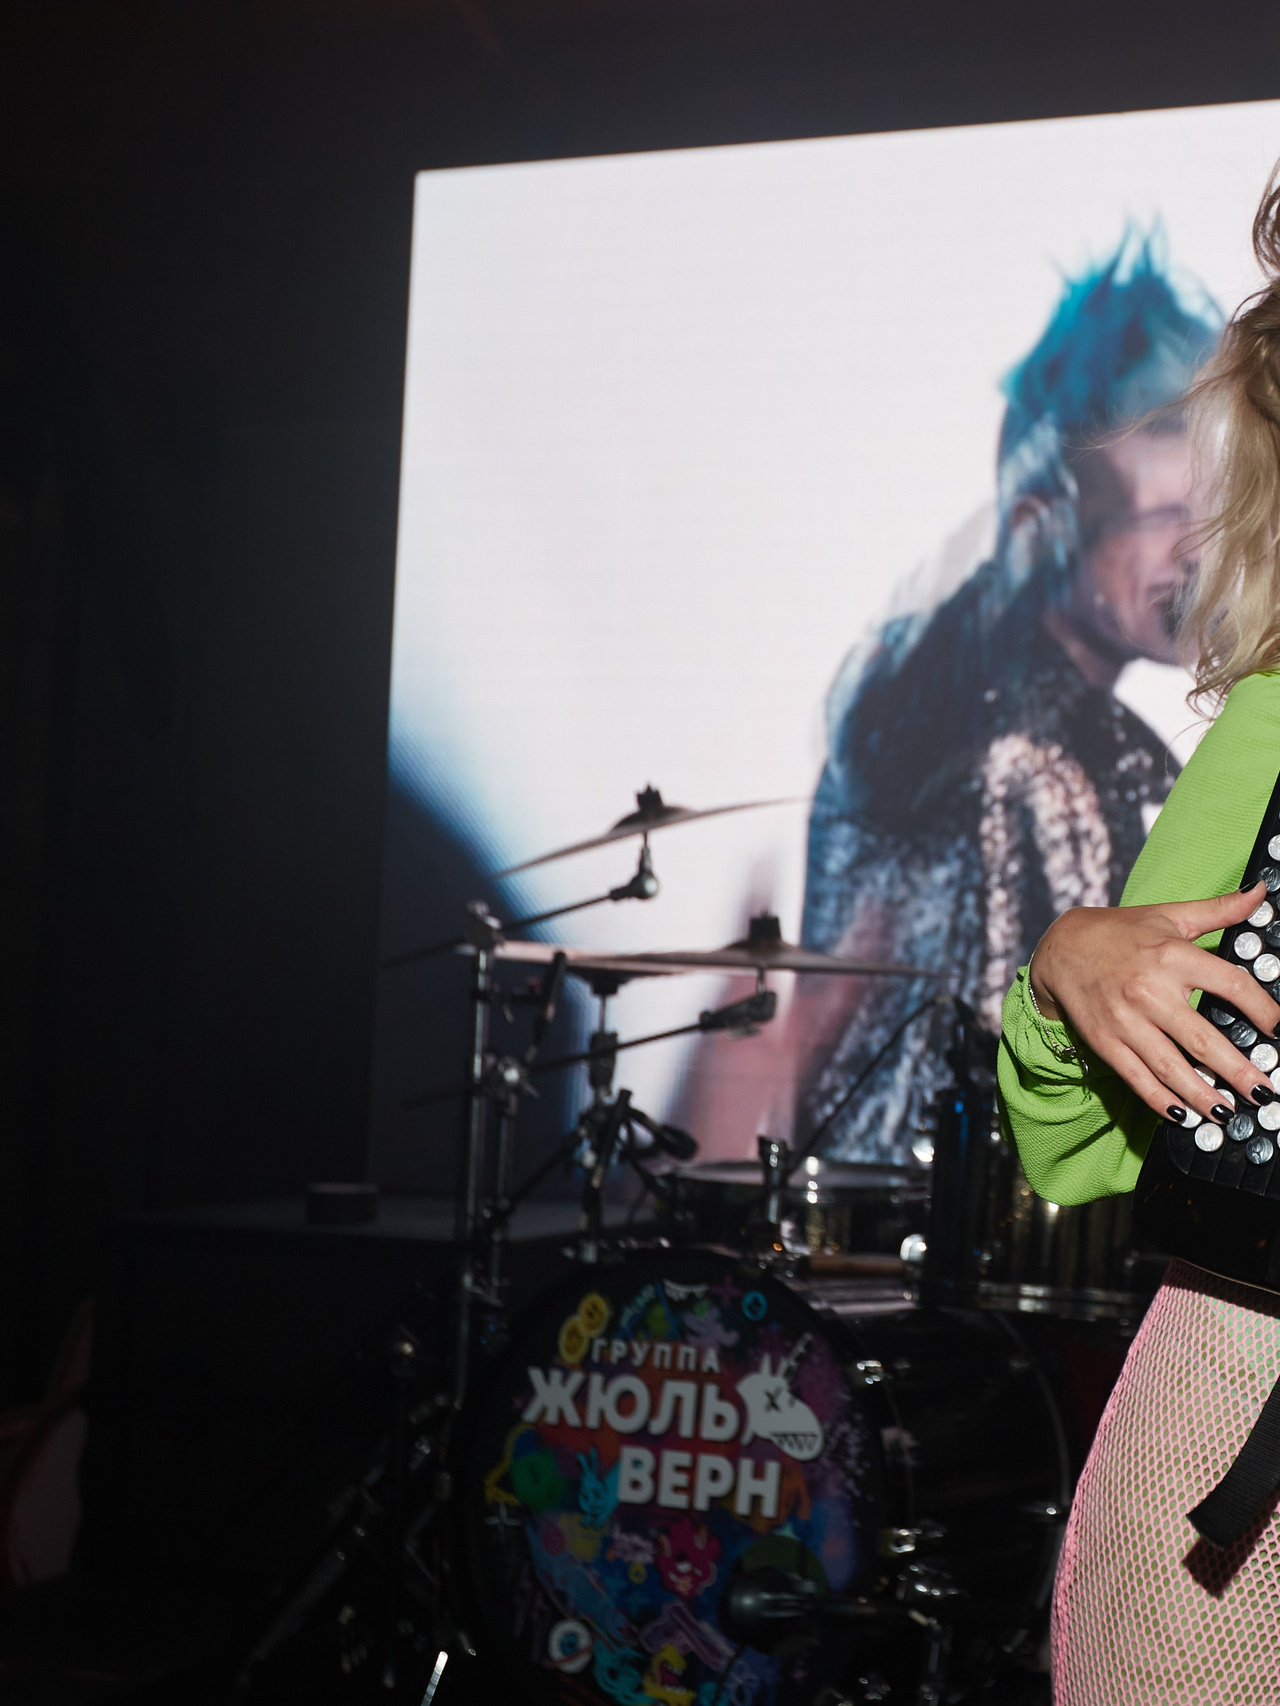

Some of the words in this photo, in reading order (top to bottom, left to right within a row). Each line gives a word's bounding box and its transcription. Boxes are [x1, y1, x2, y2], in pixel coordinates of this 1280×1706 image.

[591, 1338, 721, 1374] ГРУППА
[521, 1366, 740, 1443] ЖЮЛЬ
[616, 1444, 782, 1519] ВЕРН
